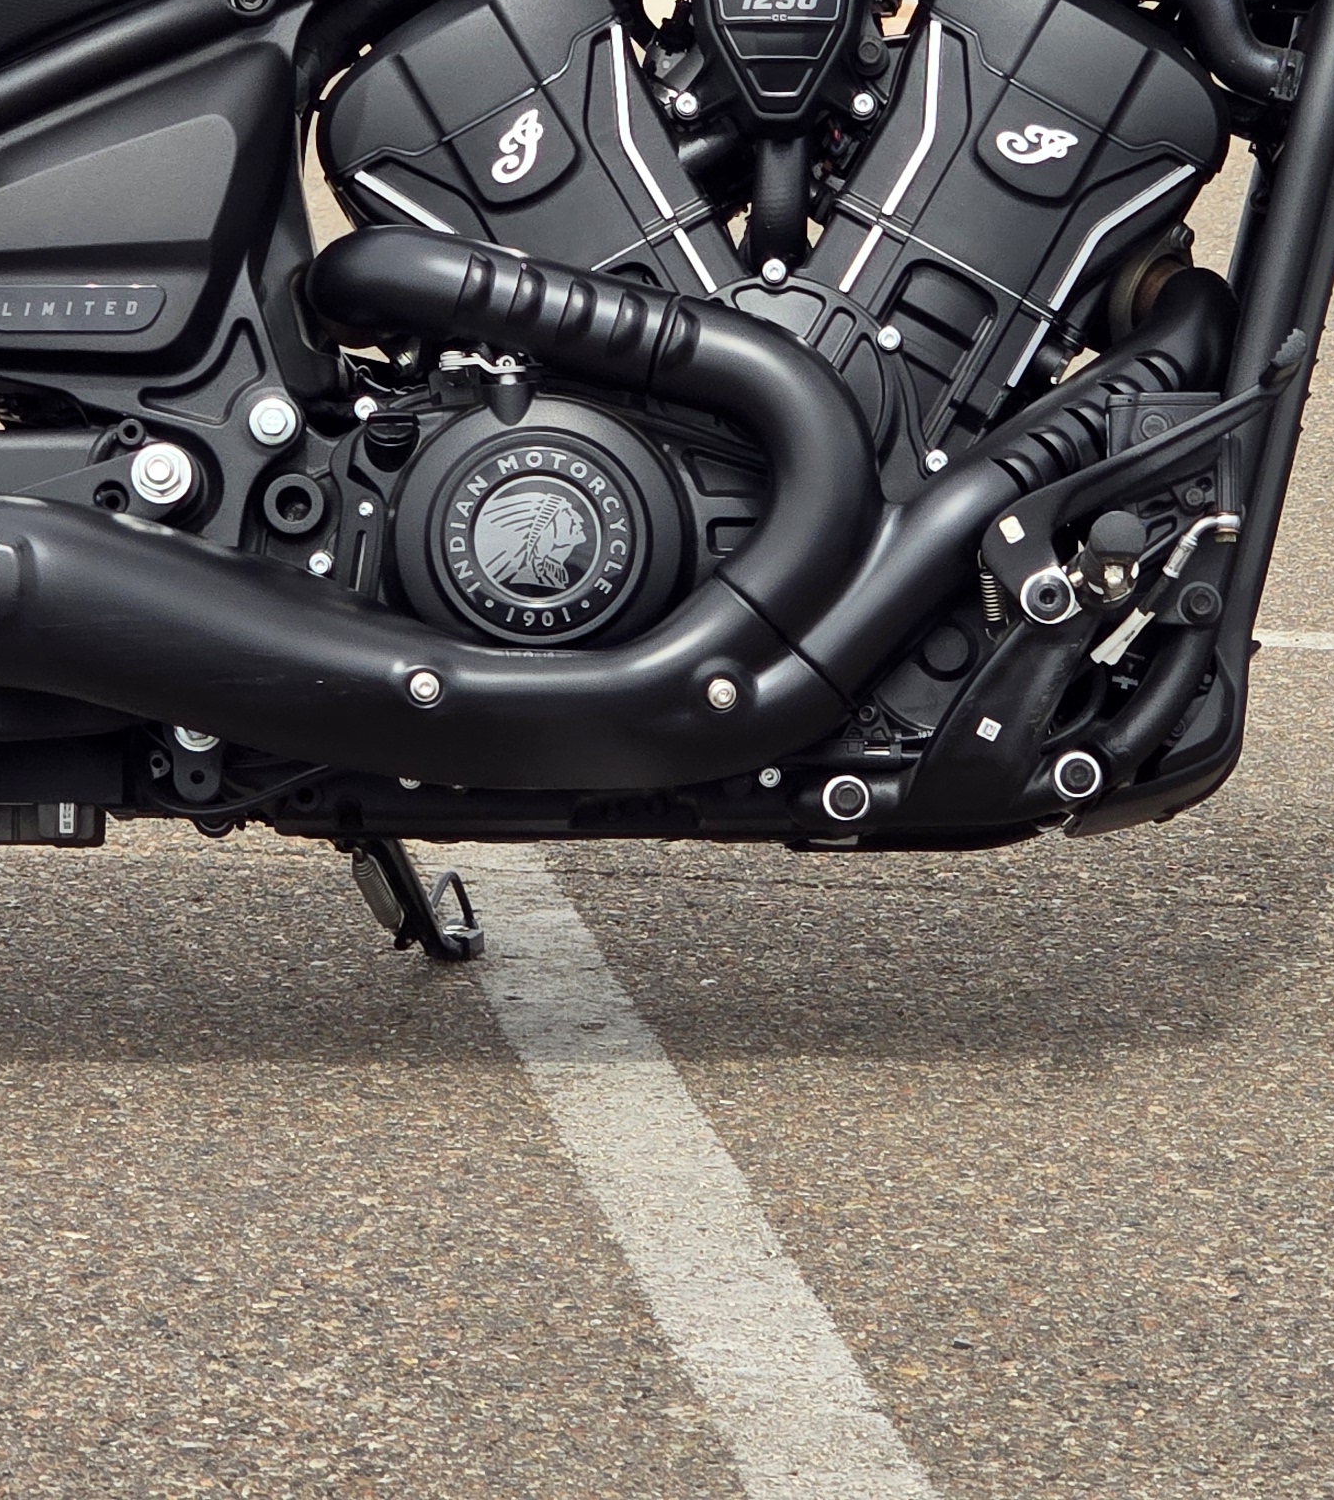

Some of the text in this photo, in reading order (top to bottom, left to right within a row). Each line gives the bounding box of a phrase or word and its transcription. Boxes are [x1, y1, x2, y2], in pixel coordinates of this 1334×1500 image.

[1, 300, 139, 317] LIMITED
[449, 451, 628, 595] INDIAN MOTORCYCLE
[505, 606, 573, 628] 1901
